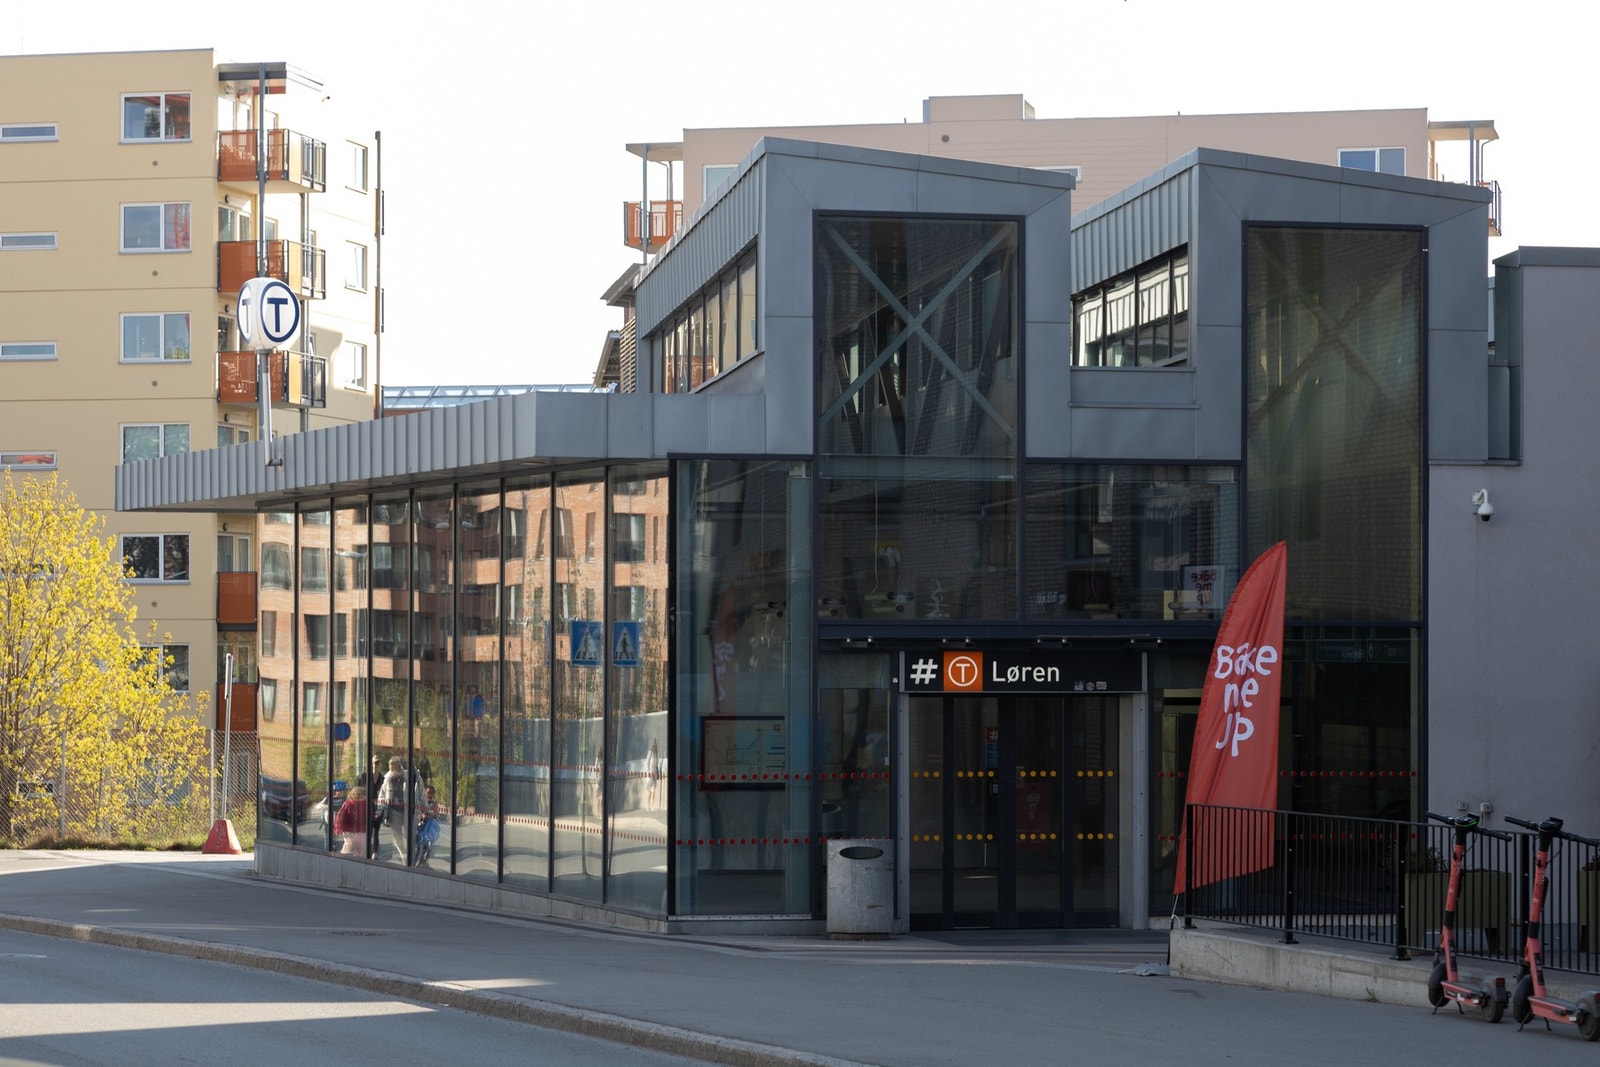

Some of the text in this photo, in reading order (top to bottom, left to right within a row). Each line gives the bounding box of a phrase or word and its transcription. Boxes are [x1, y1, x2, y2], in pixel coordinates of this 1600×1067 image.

[267, 297, 288, 333] T
[955, 663, 971, 683] T
[992, 660, 1060, 683] Løren
